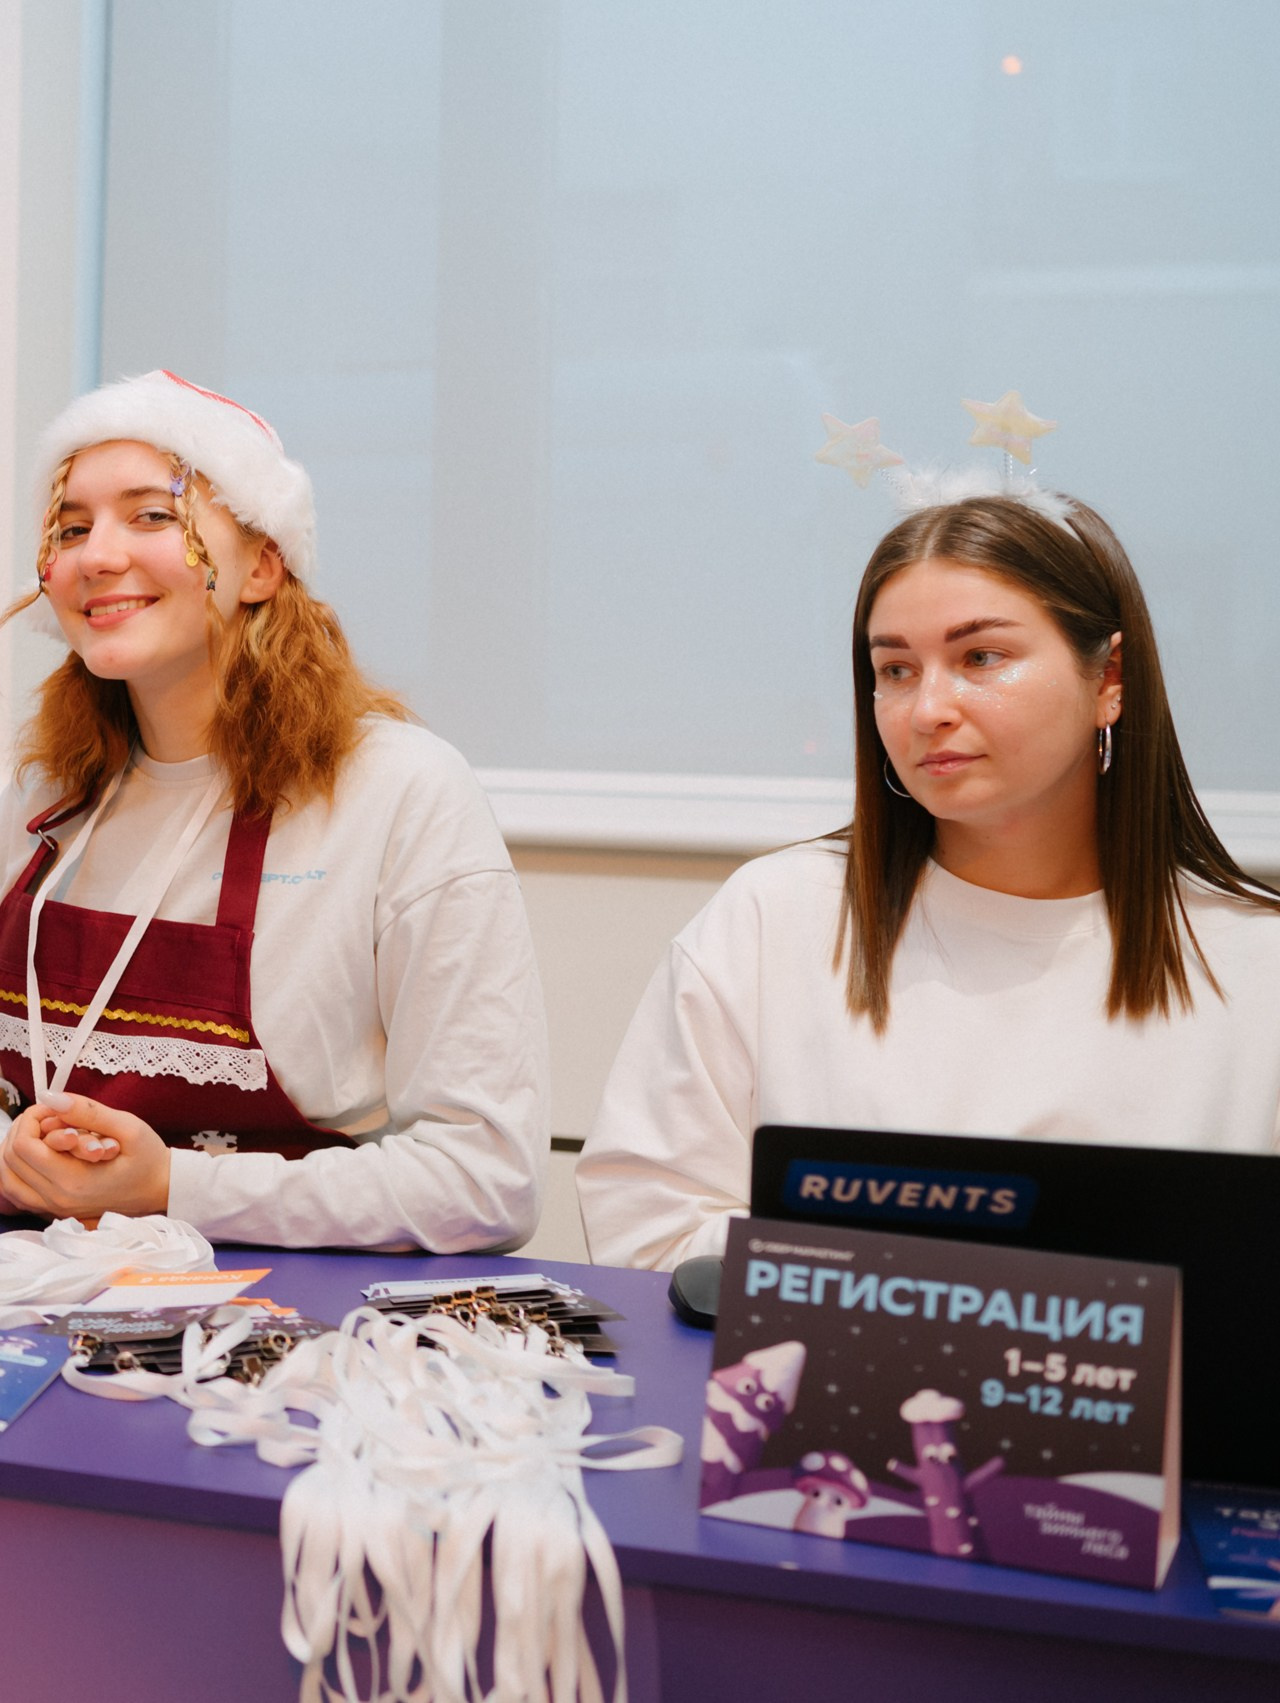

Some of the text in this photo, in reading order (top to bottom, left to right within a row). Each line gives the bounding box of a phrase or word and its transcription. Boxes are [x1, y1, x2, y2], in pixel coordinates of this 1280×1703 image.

[800, 1173, 1018, 1215] RUVENTS
[745, 1259, 1145, 1346] РЕГИСТРАЦИЯ
[1072, 1362, 1138, 1392] лет
[1070, 1397, 1135, 1426] лет
